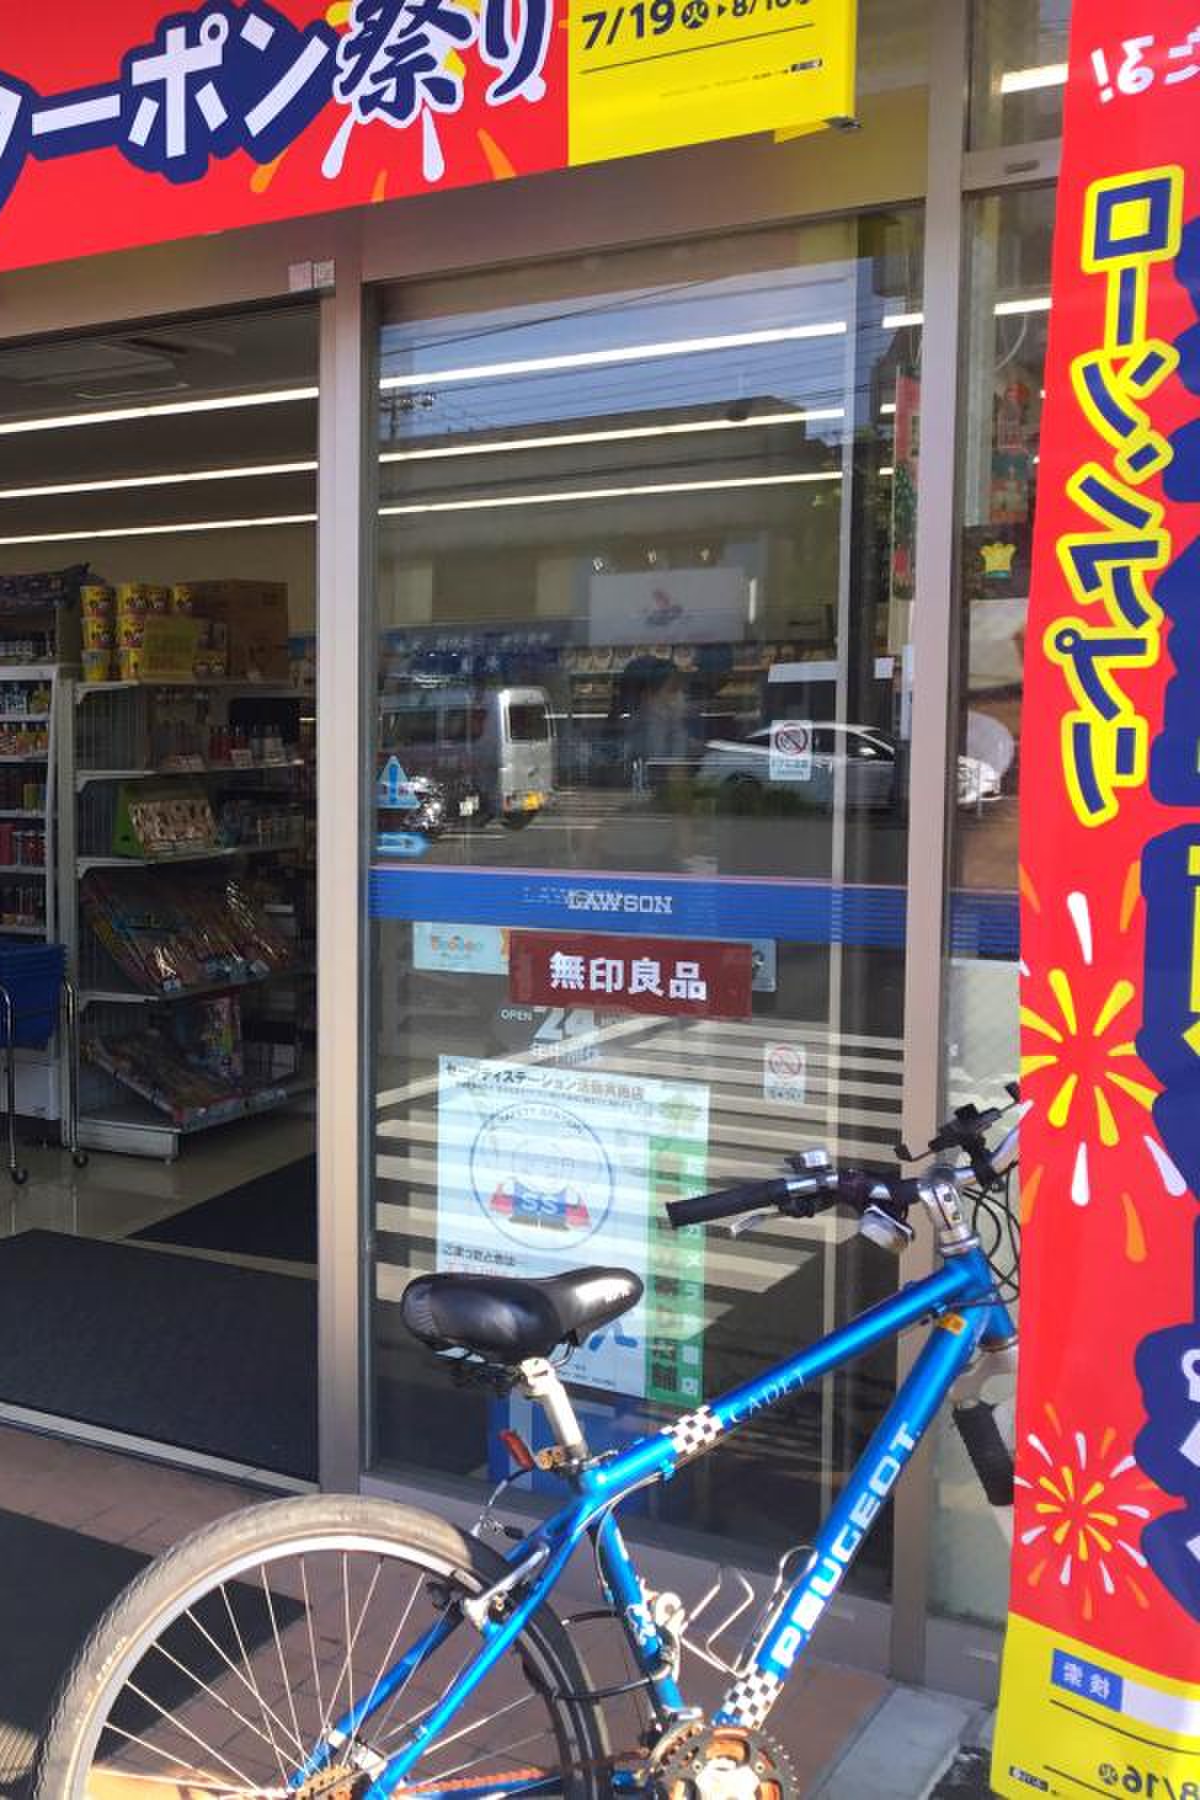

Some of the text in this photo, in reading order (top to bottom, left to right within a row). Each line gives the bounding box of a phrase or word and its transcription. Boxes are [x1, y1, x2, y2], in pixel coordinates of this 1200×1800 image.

[567, 888, 674, 914] LAWSON
[550, 951, 706, 1000] 無印良品
[500, 1008, 532, 1022] OPEN
[770, 1421, 918, 1668] PEUGEOT
